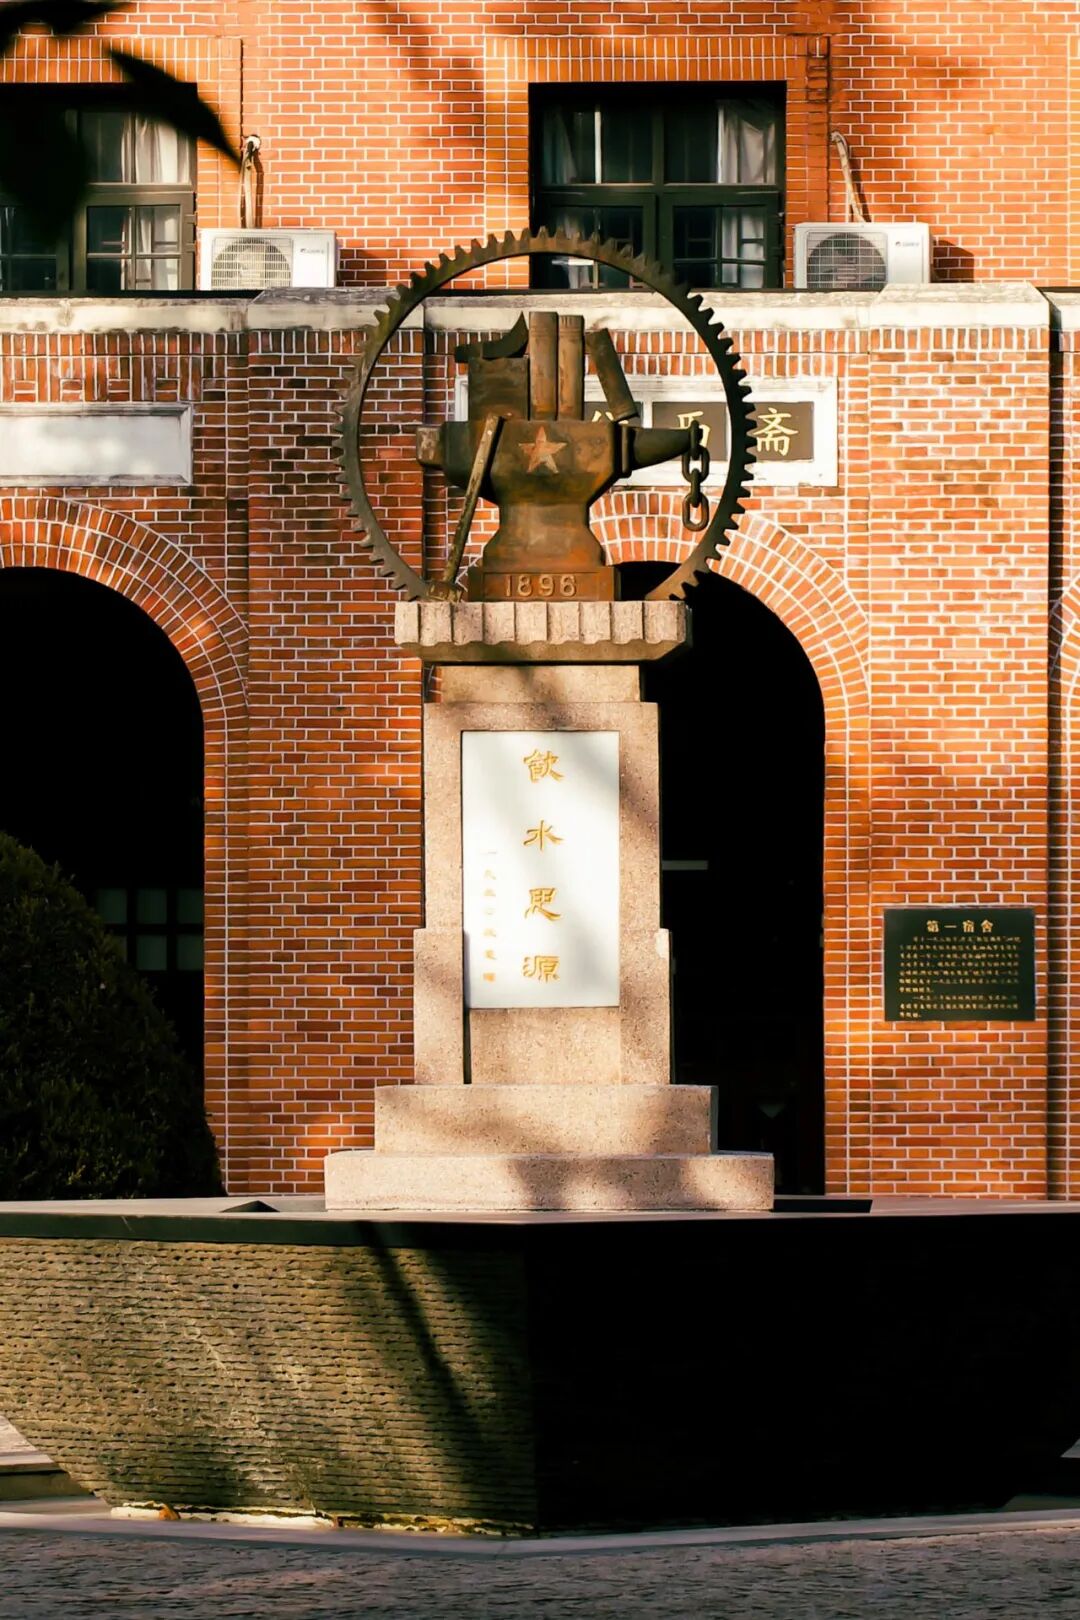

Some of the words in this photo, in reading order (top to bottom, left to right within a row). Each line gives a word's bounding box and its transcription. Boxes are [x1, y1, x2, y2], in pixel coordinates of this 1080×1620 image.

[504, 573, 577, 597] 1896
[926, 919, 994, 933] 第一宿舍
